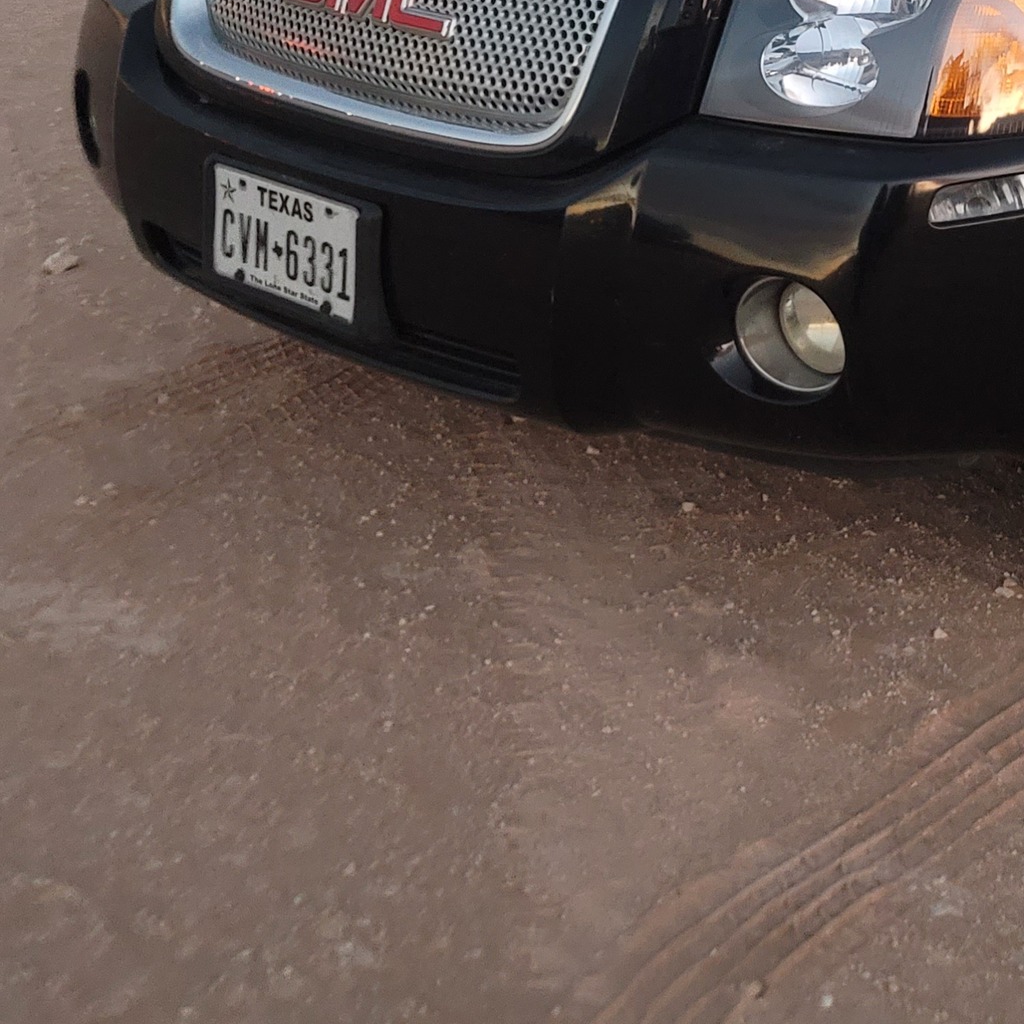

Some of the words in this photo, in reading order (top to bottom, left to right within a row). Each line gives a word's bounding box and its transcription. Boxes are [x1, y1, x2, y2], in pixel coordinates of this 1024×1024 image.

[256, 185, 314, 223] TEXAS
[285, 229, 350, 302] 6331
[250, 274, 263, 285] The
[283, 286, 299, 298] Star
[300, 292, 319, 306] State
